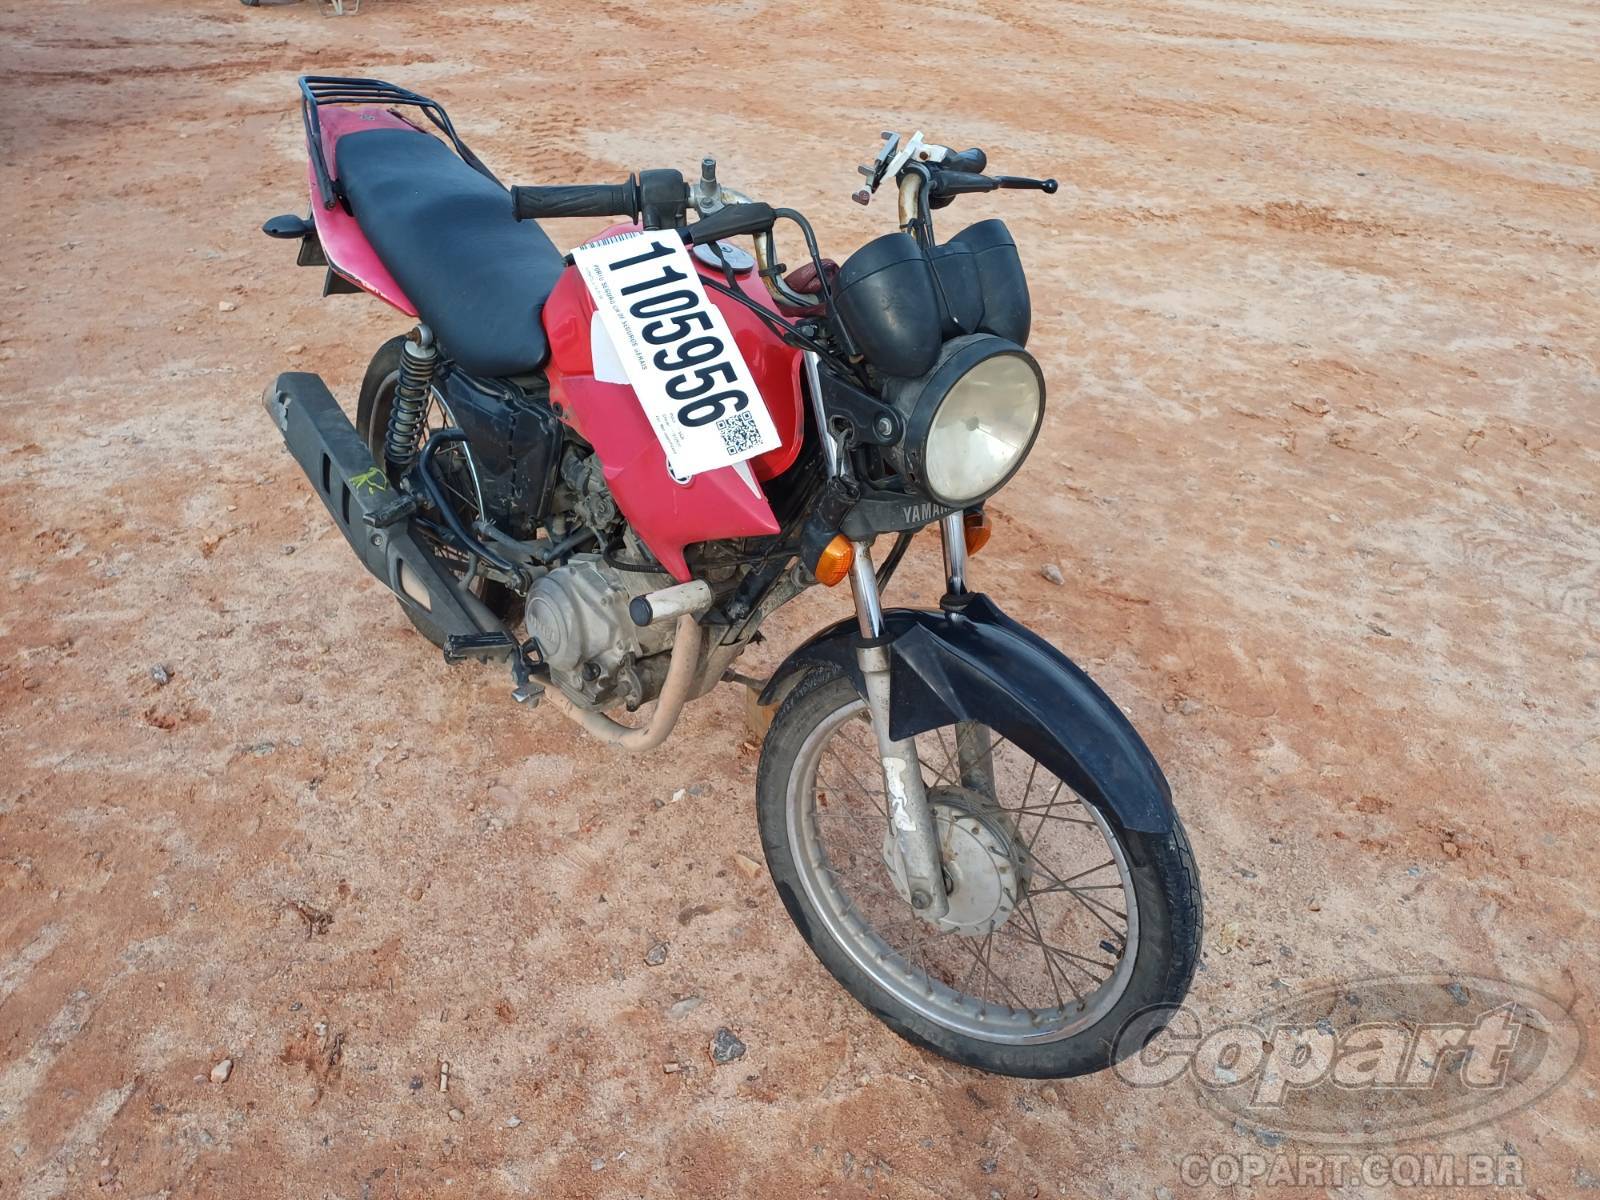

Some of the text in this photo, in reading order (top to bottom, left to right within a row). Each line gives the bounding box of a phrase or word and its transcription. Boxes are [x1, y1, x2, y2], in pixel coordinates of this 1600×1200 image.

[608, 241, 749, 428] 1105956
[622, 319, 639, 348] SEGUROS
[903, 502, 951, 523] YAMA
